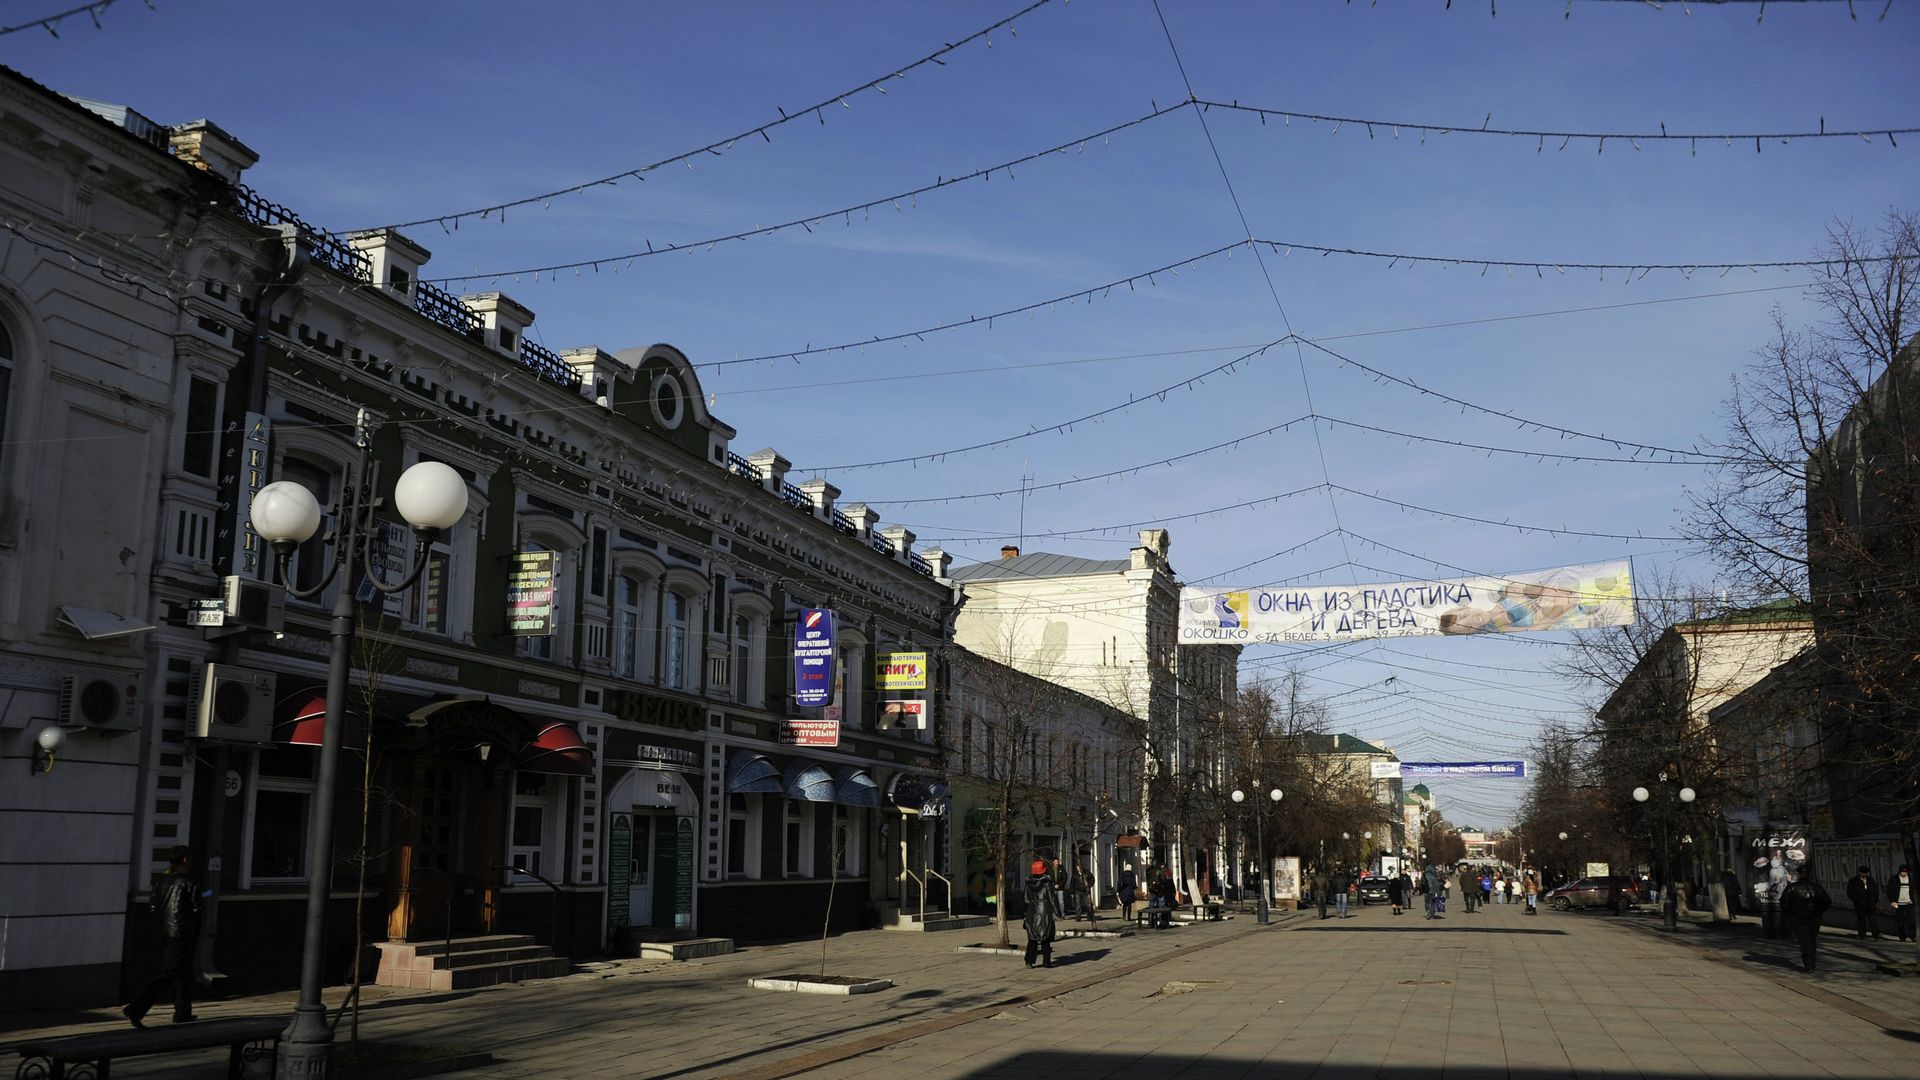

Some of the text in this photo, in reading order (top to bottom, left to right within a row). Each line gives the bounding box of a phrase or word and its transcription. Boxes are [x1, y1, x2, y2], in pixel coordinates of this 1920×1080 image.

[243, 448, 266, 573] ЮВИР
[1258, 583, 1472, 612] ОКНА ИЗ ПЛАСТИКА
[1312, 609, 1417, 634] И ДЕРЕВА
[1183, 628, 1248, 639] ОКОШКО
[1265, 632, 1278, 642] ТД
[1284, 631, 1318, 641] ВЕЛЕС
[1323, 632, 1330, 642] 3
[877, 664, 917, 676] КНИГИ
[622, 690, 706, 731] ВЕЛЕС
[1491, 765, 1515, 773] банке
